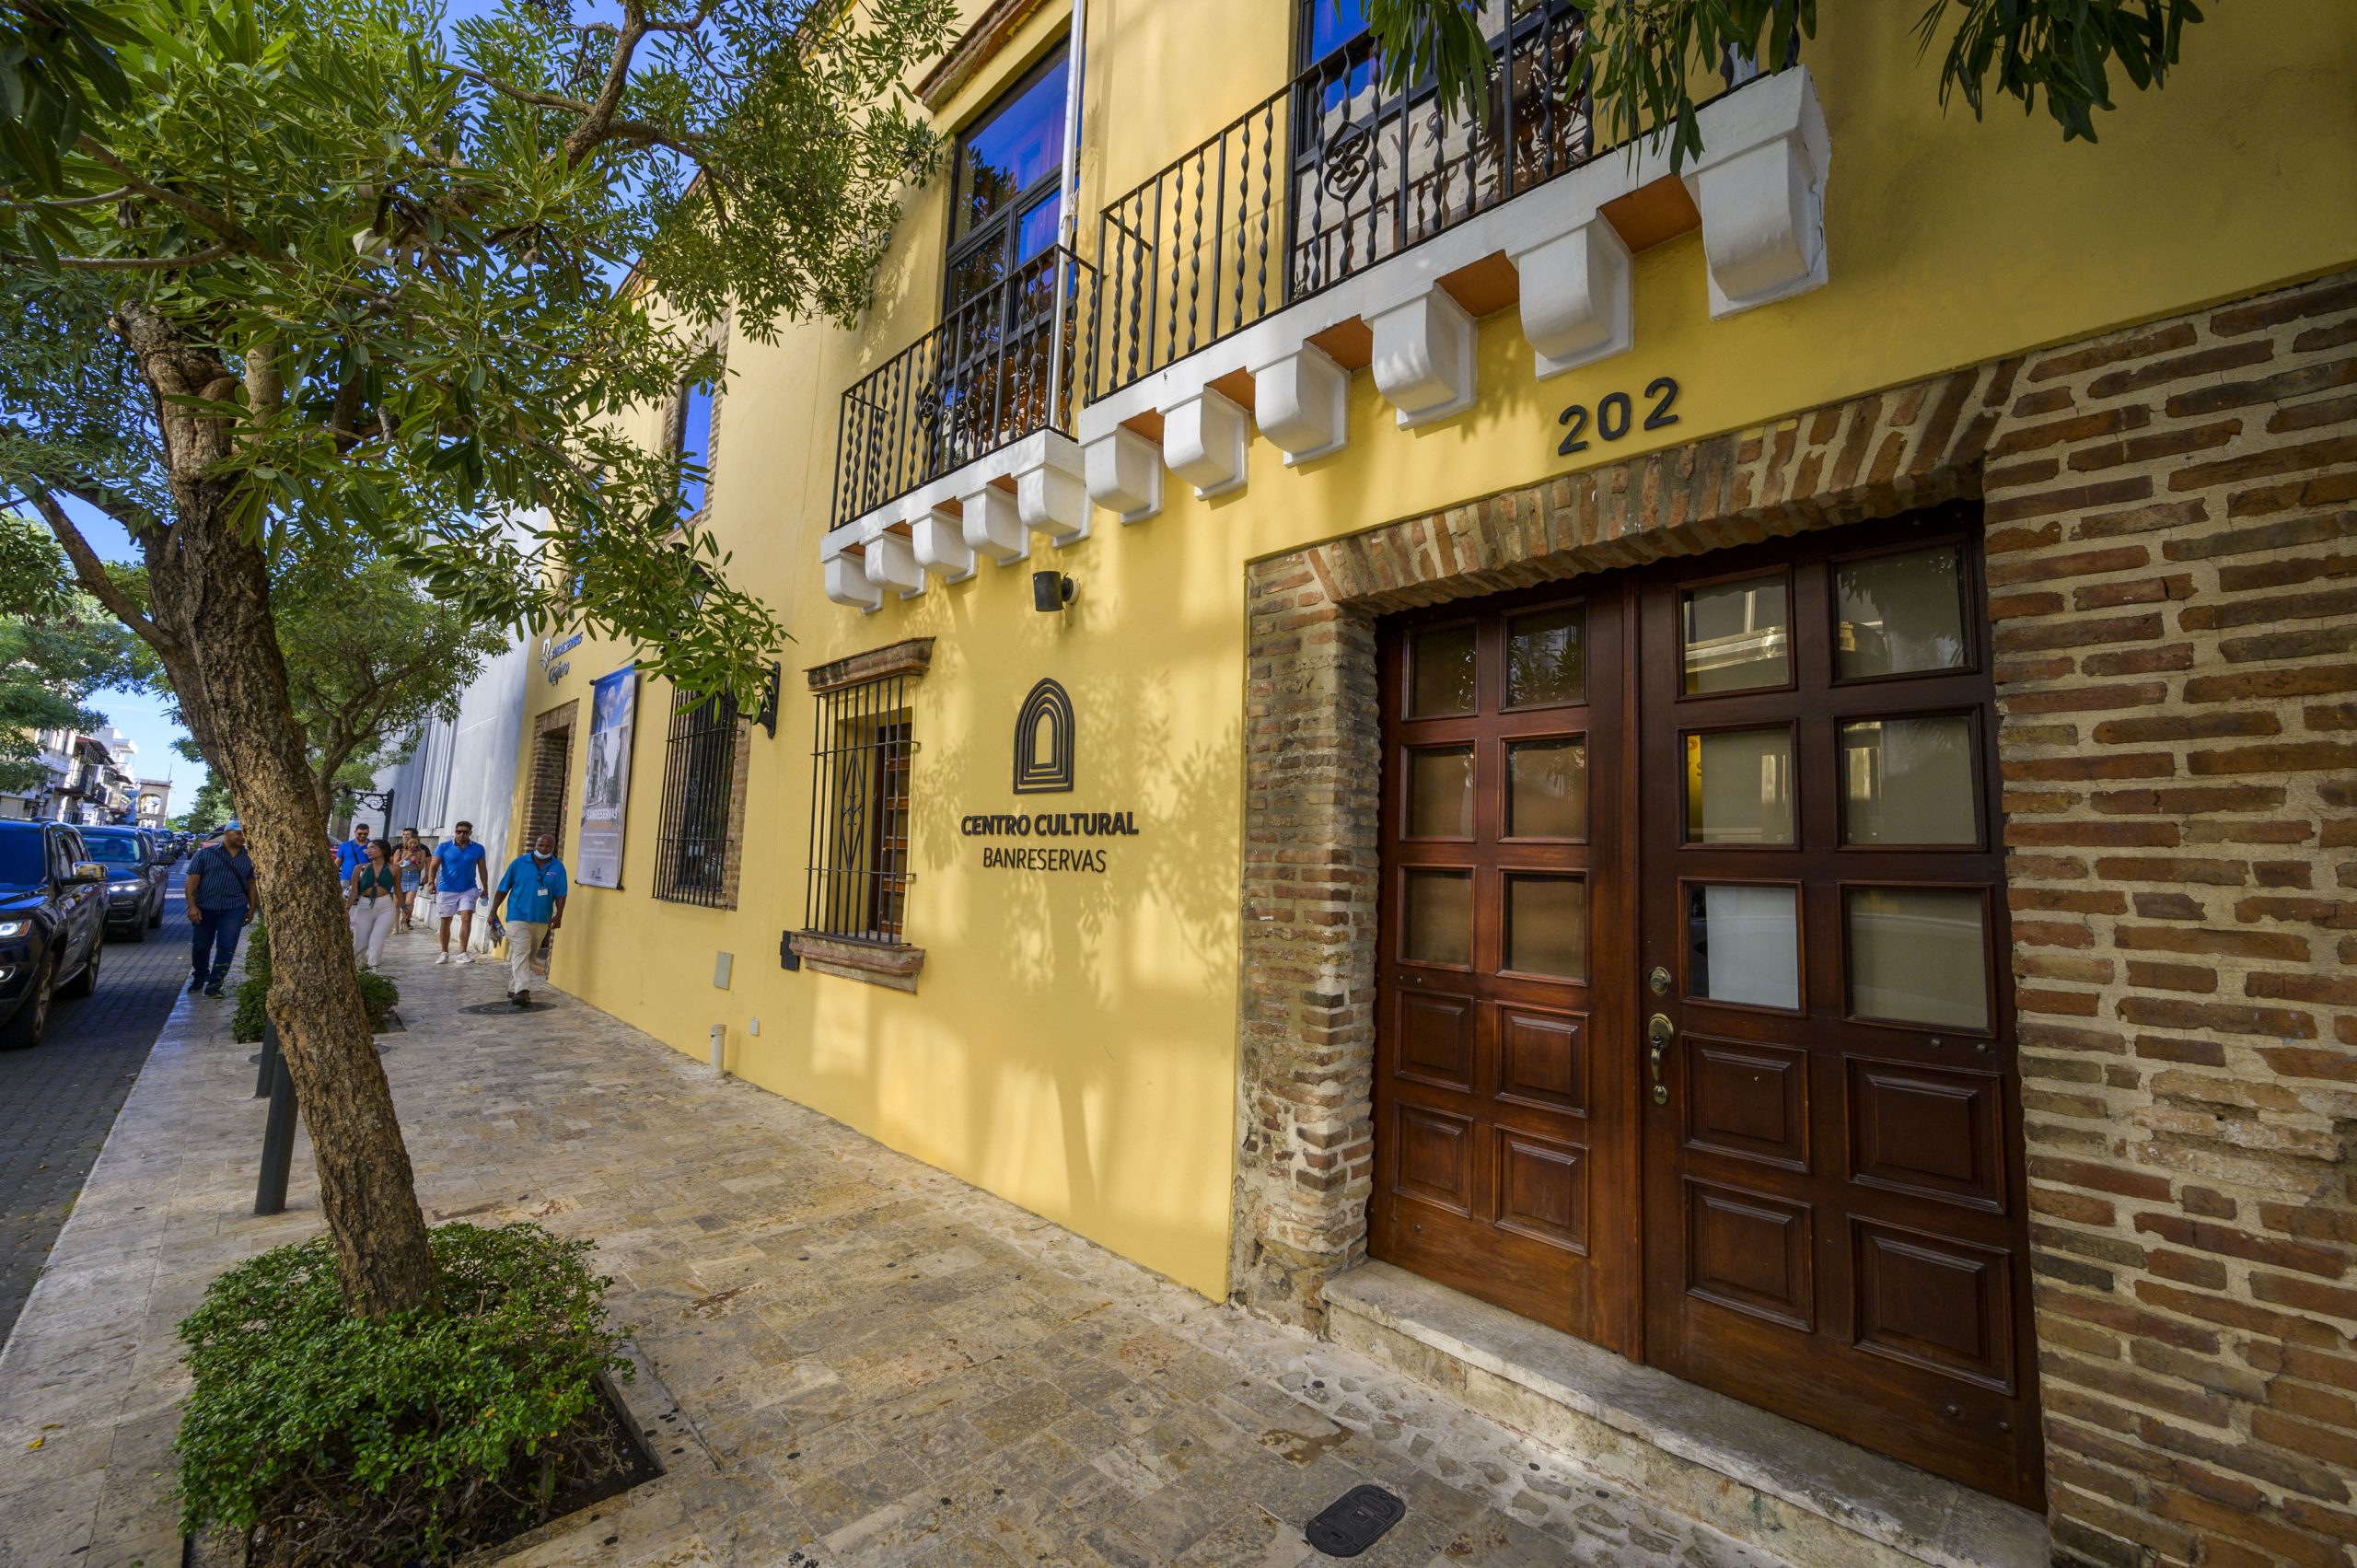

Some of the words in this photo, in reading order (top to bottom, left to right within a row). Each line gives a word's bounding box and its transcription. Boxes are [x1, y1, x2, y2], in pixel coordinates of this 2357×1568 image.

[1558, 377, 1678, 457] 202
[960, 814, 1031, 836] CENTRO
[1034, 811, 1140, 836] CULTURAL
[982, 847, 1107, 873] BANRESERVAS
